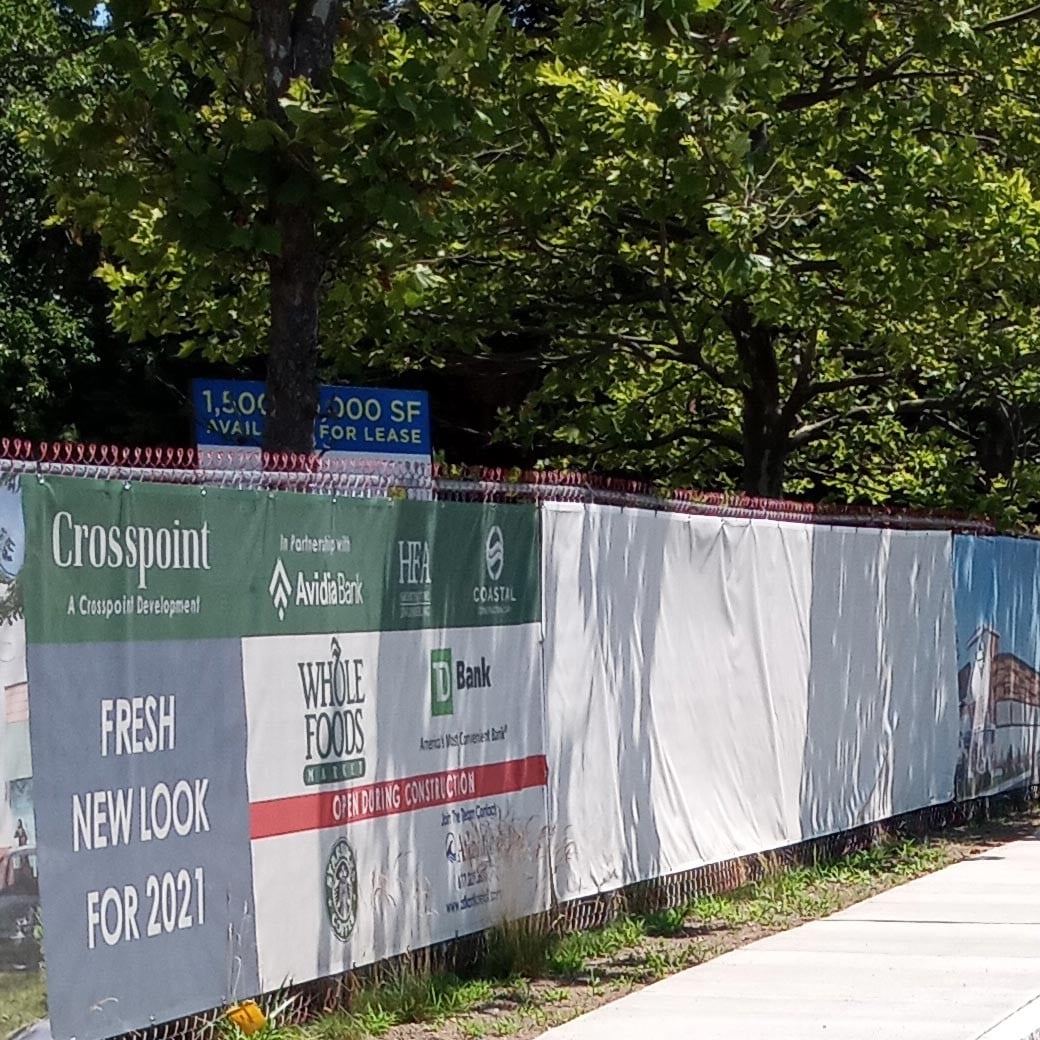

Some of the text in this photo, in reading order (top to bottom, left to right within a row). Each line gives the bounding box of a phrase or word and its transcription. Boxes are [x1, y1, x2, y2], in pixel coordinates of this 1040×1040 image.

[320, 425, 357, 440] FOR
[364, 427, 422, 444] LEASE
[391, 400, 422, 423] SF
[53, 511, 211, 589] Crosspoint
[397, 541, 432, 584] HFA
[67, 595, 200, 619] A Crosspoint Development
[473, 586, 517, 602] COASTAL
[297, 659, 366, 710] WHOLE
[432, 656, 492, 702] TD Bank
[101, 694, 175, 756] FRESH
[304, 709, 365, 760] FOODS
[72, 778, 210, 852] NEW LOOK
[332, 771, 476, 820] OPEN DURING CONSTRUCTION
[87, 867, 204, 949] FOR 2021
